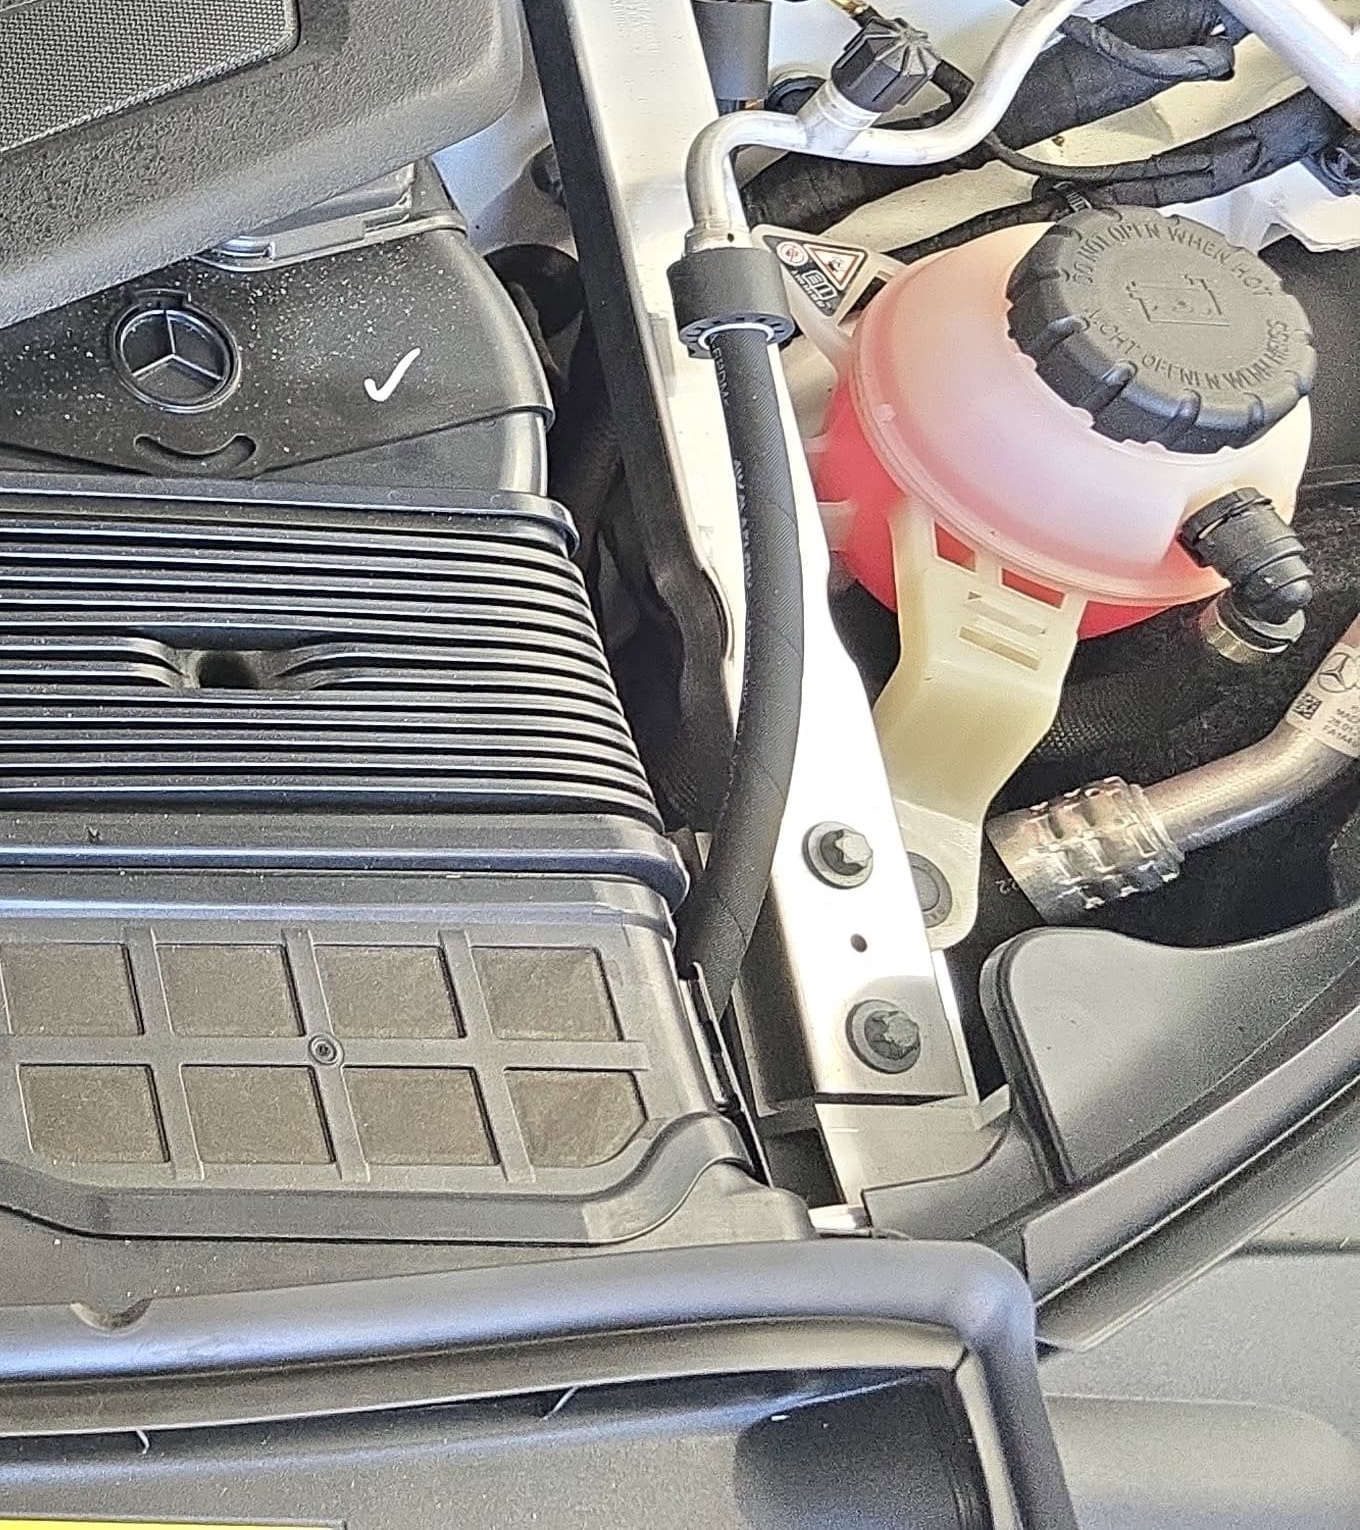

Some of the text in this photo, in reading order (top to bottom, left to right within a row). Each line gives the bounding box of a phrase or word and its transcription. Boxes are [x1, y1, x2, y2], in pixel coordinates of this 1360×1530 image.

[1107, 223, 1161, 242] OPEN
[1167, 226, 1232, 264] WHEN
[1232, 262, 1273, 296] HOT
